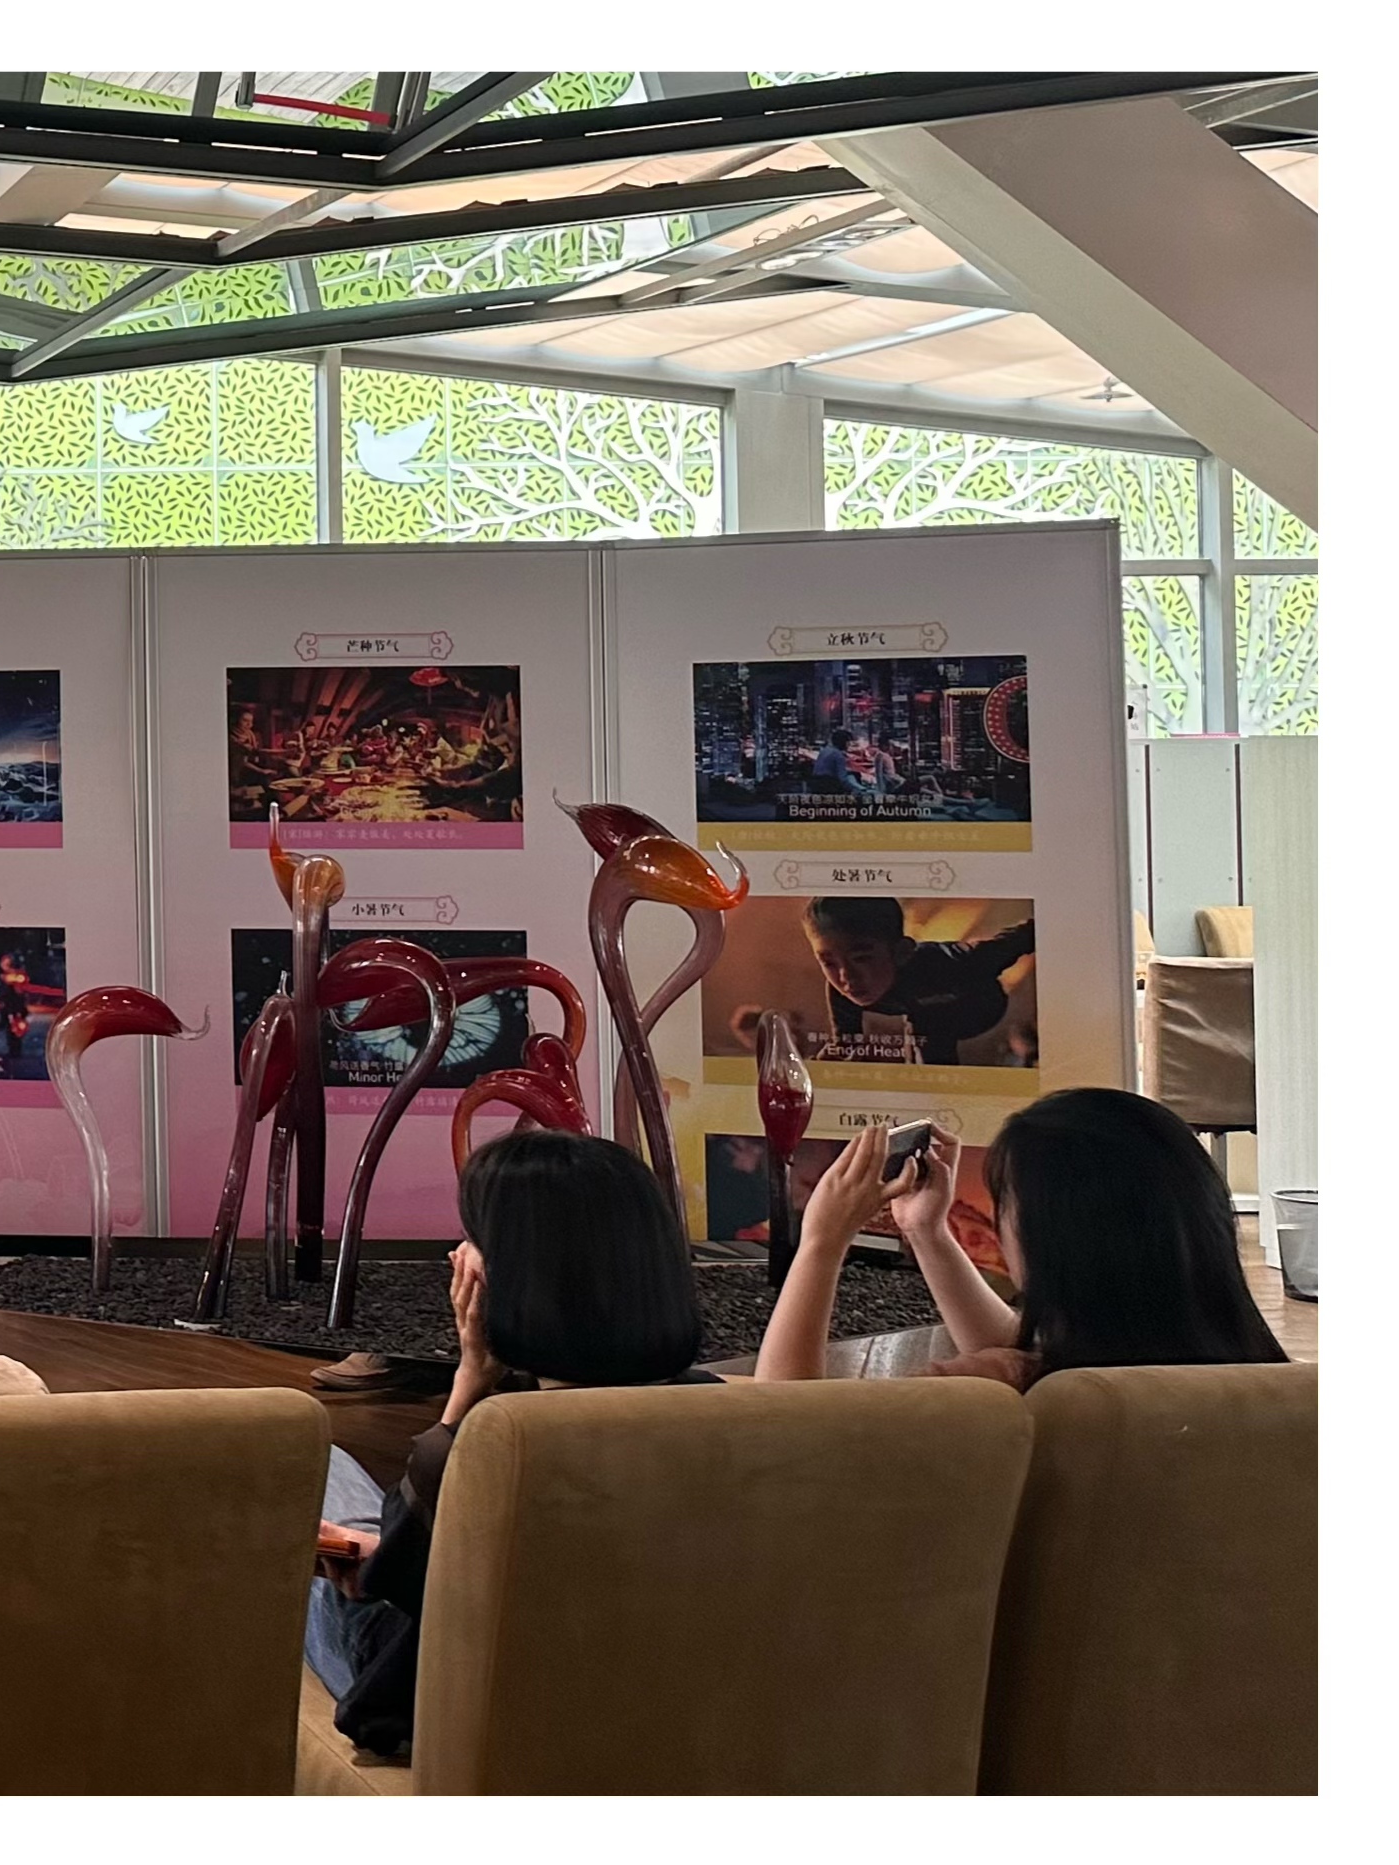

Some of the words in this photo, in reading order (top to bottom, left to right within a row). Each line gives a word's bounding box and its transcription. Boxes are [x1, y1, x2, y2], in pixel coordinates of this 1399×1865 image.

[346, 639, 399, 653] 芒种节气
[827, 632, 886, 647] 立秋节气
[789, 805, 857, 820] Beginning
[859, 805, 874, 816] of
[876, 805, 932, 816] Autumn
[832, 868, 893, 883] 处暑节气
[352, 903, 405, 916] 小暑节气
[827, 1044, 853, 1057] End
[857, 1044, 871, 1057] of
[873, 1045, 907, 1058] Heat
[348, 1071, 384, 1083] Minor
